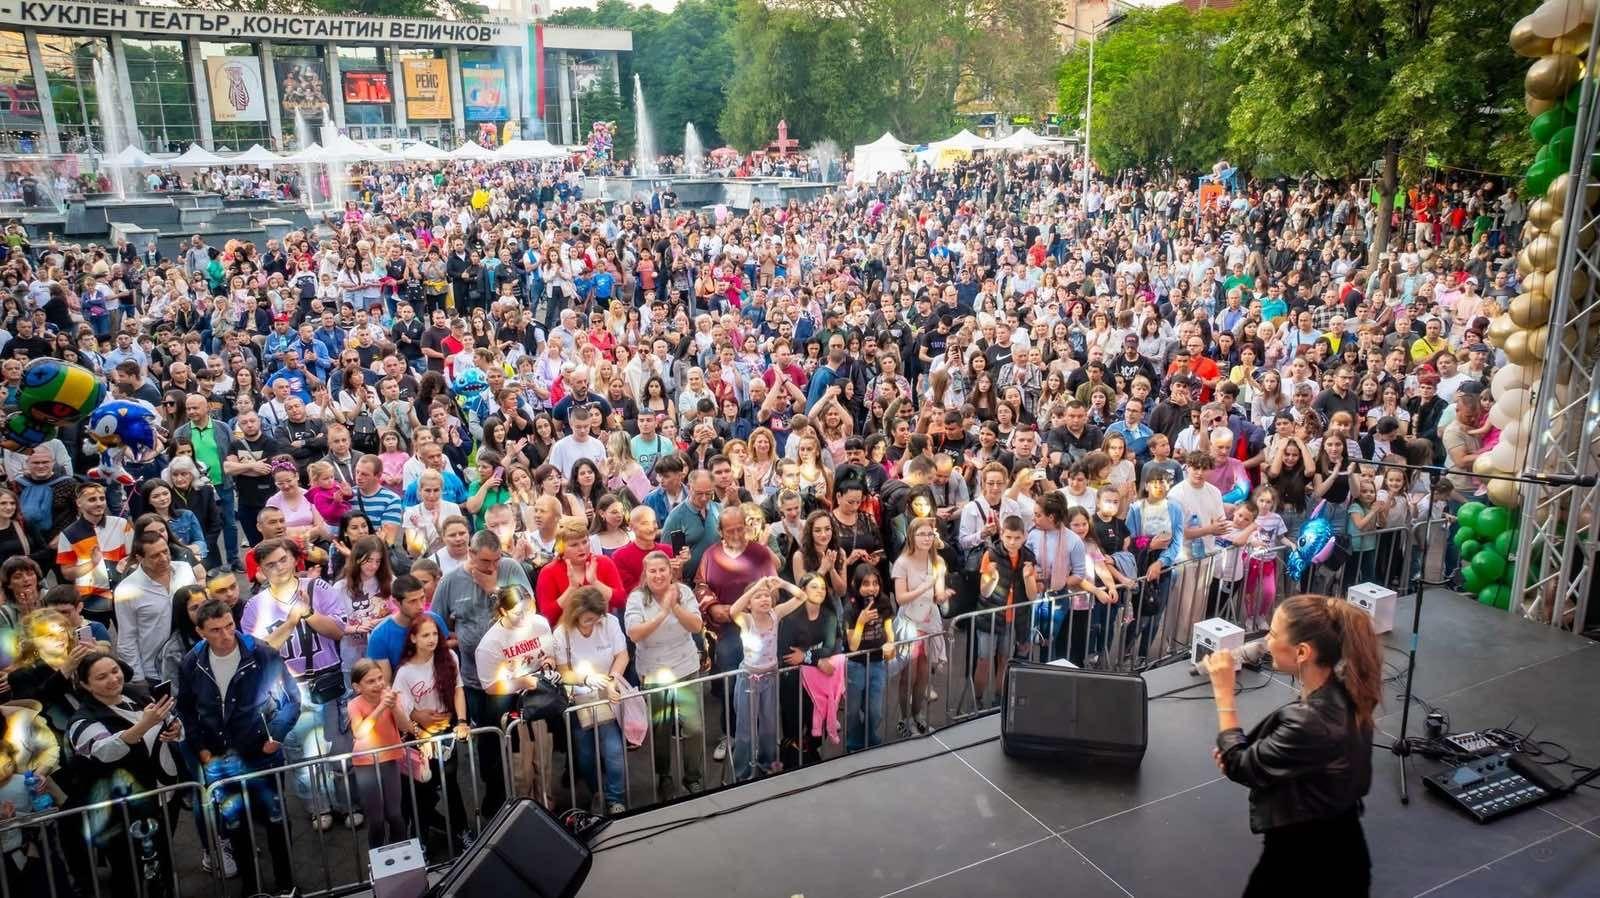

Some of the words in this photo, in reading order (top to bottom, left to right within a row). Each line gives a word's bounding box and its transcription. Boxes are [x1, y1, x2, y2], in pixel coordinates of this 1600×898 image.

[21, 1, 127, 27] КУКЛЕН
[135, 10, 230, 31] ТЕАТЪР
[415, 71, 439, 89] РЕЙС
